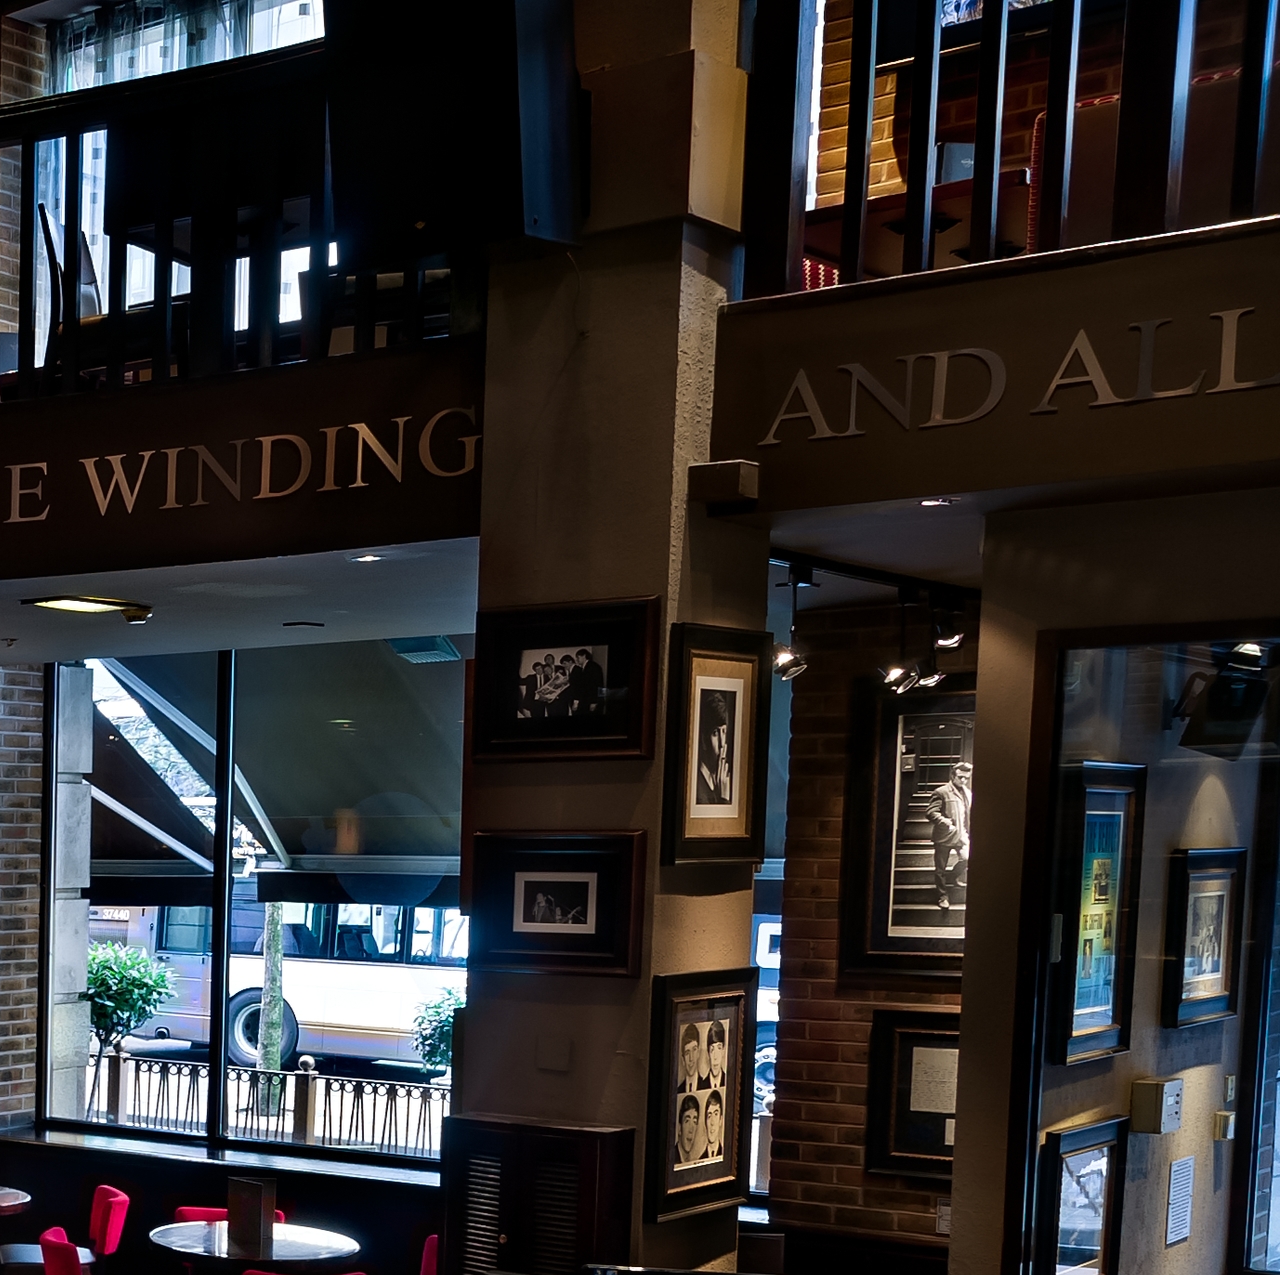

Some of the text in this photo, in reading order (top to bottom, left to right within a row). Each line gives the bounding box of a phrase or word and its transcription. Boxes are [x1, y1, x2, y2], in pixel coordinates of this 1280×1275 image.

[757, 306, 1280, 447] AND ALL
[77, 405, 483, 517] WINDING
[102, 908, 130, 920] 37440
